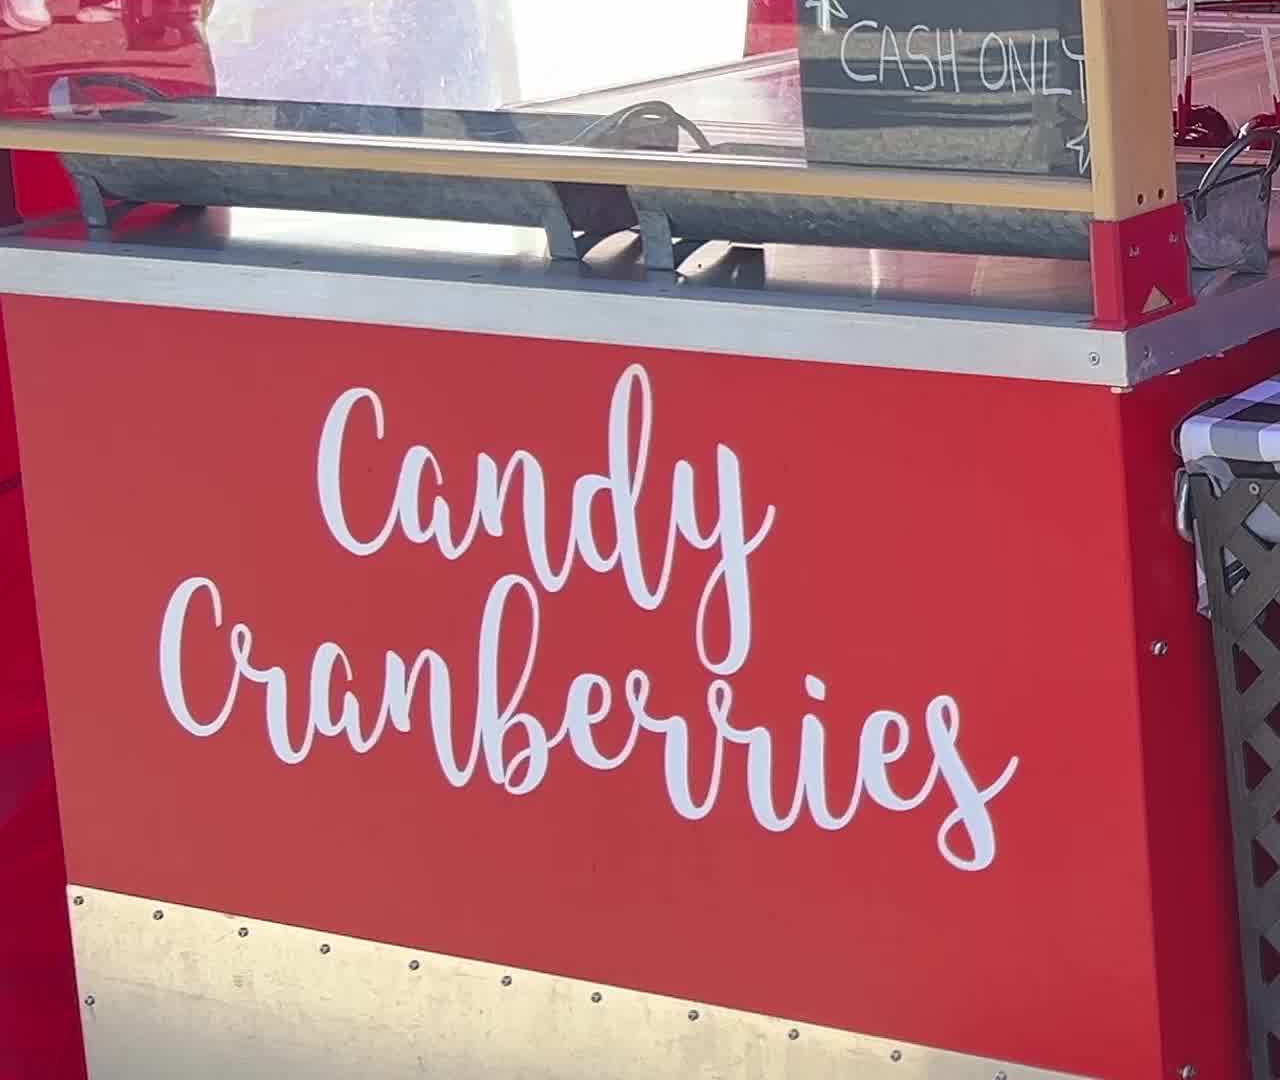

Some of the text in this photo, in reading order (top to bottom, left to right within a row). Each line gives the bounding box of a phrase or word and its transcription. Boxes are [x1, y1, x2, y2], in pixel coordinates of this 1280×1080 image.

[839, 20, 1086, 105] CASH ONLY
[317, 363, 776, 675] Candy
[159, 573, 1019, 871] Cranberries
